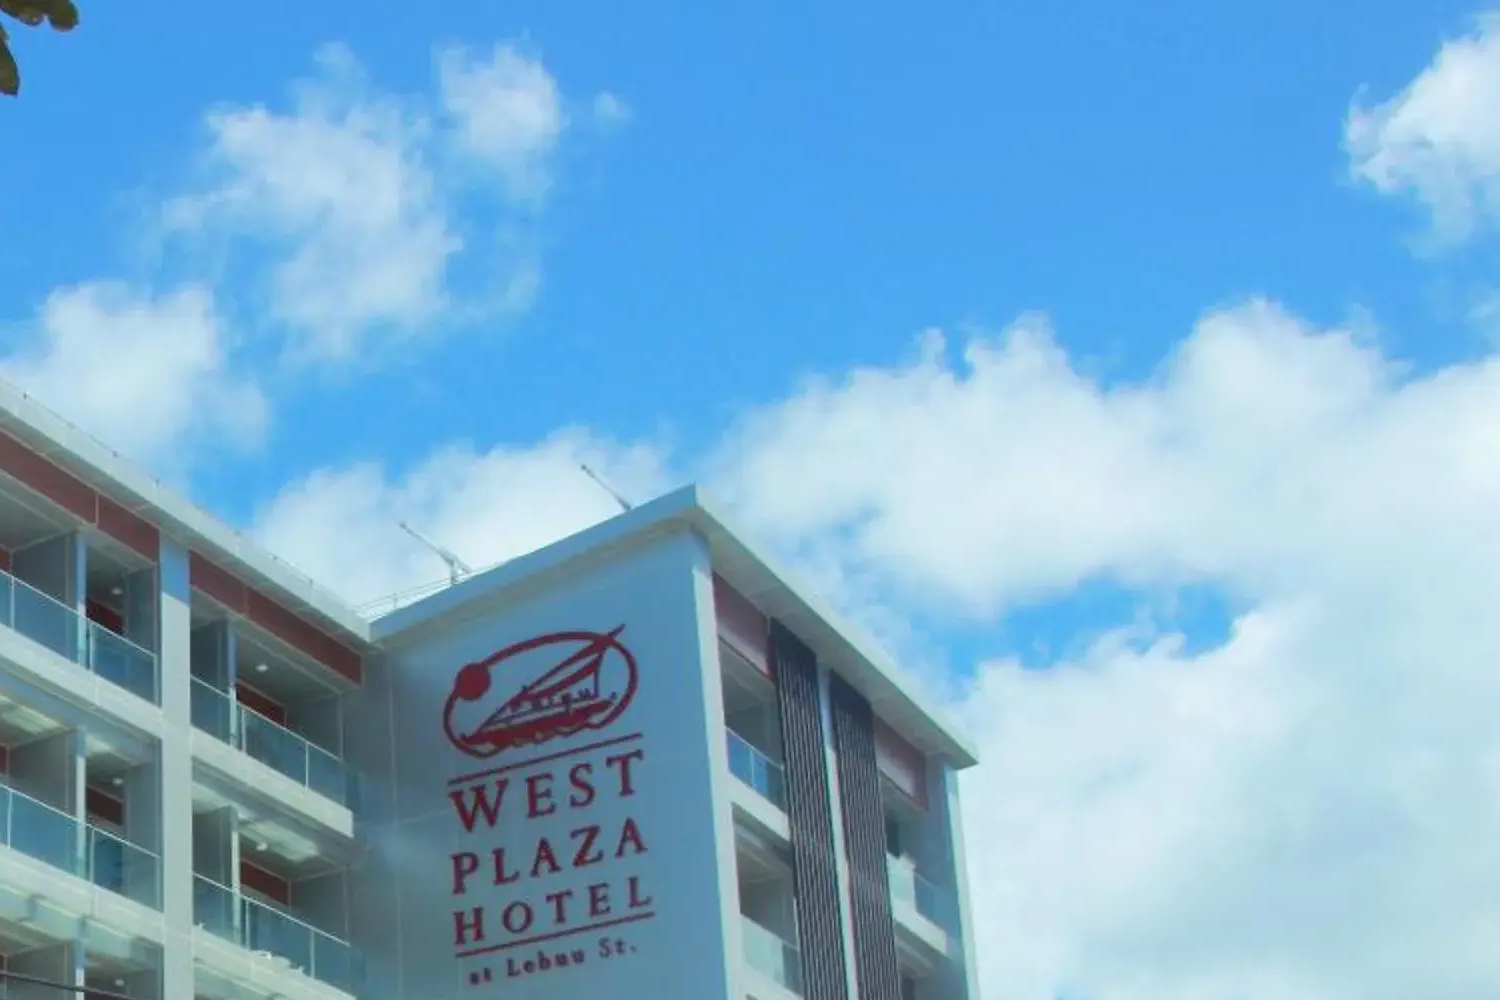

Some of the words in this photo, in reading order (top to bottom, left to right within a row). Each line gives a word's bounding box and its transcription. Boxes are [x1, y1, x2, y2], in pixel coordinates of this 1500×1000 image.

[449, 748, 644, 834] WEST
[451, 816, 649, 896] PLAZA
[453, 875, 652, 946] HOTEL
[598, 937, 637, 958] St.
